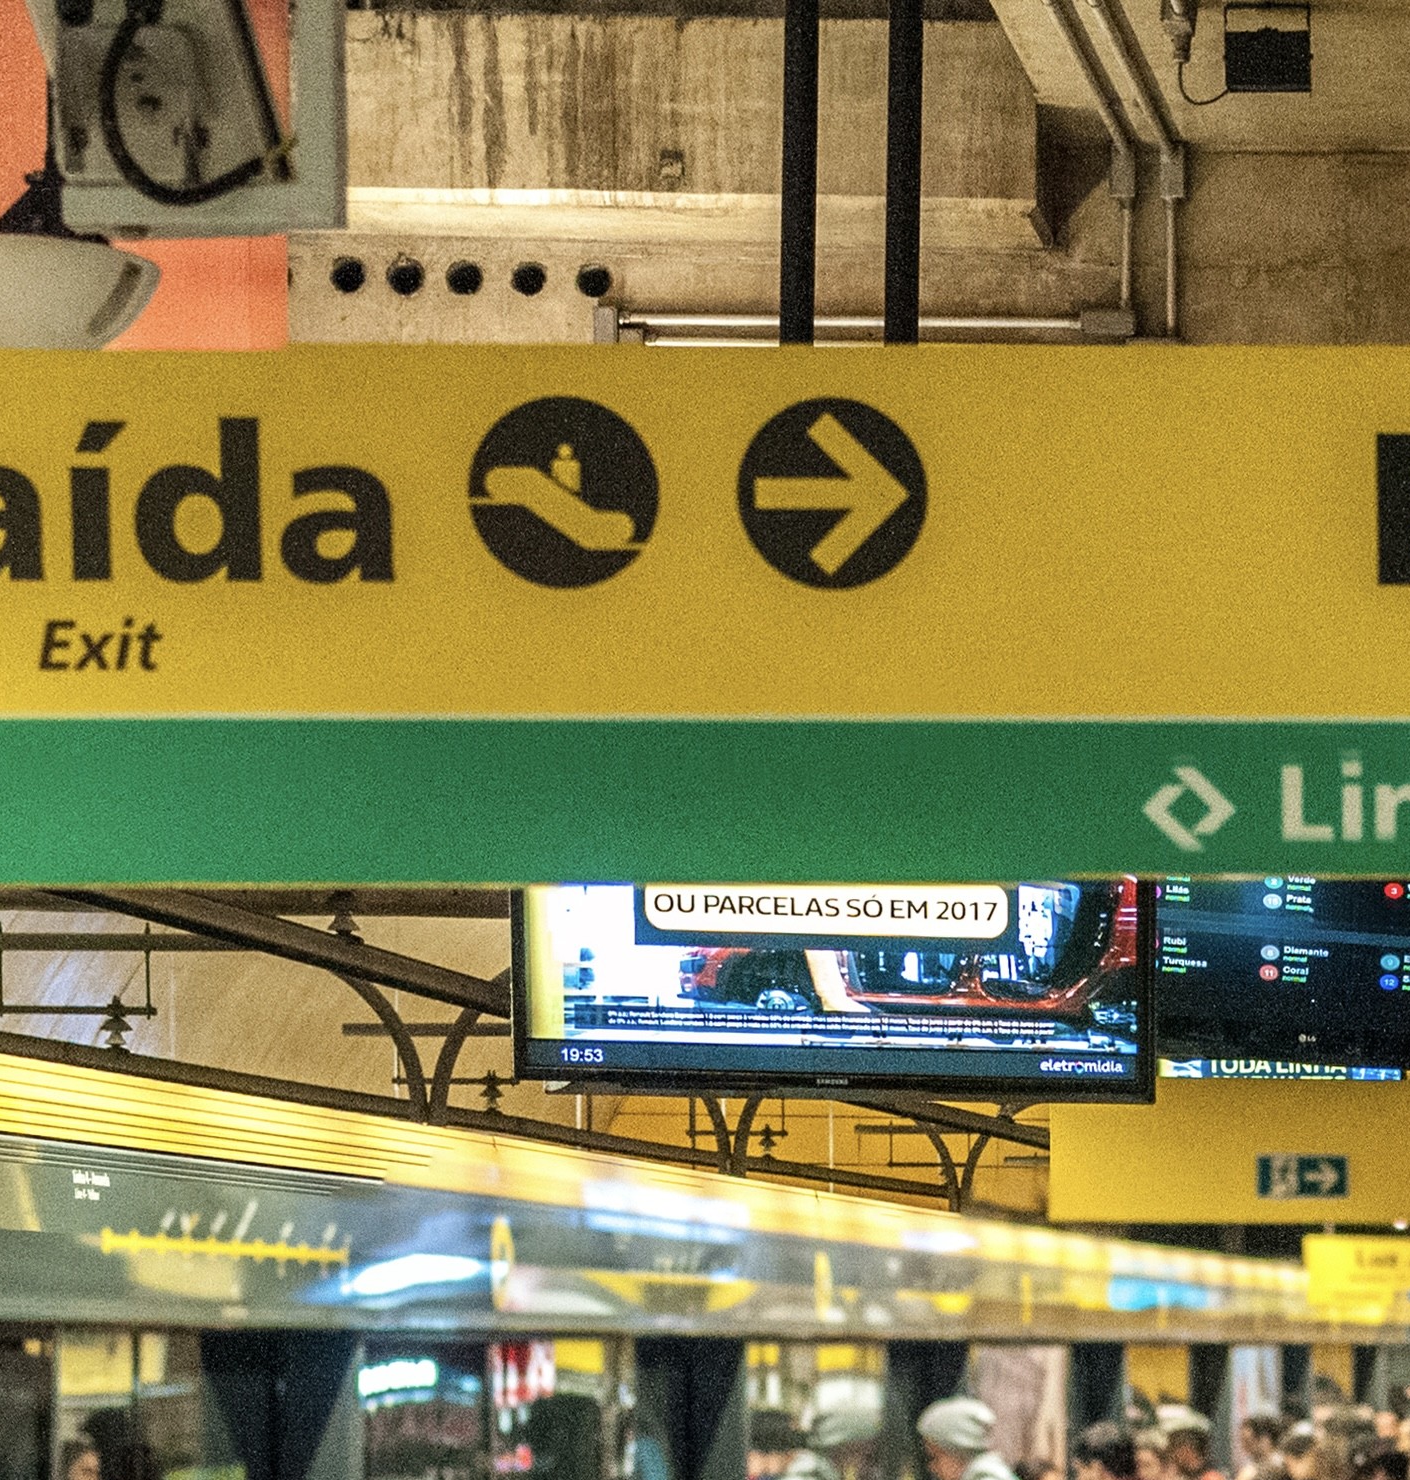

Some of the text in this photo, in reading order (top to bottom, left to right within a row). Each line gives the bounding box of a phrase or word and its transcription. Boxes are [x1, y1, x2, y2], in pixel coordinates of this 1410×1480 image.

[39, 616, 163, 671] Exit
[654, 893, 999, 922] OU PARCELAS SÓ EM 2017
[560, 1048, 604, 1063] 19:53
